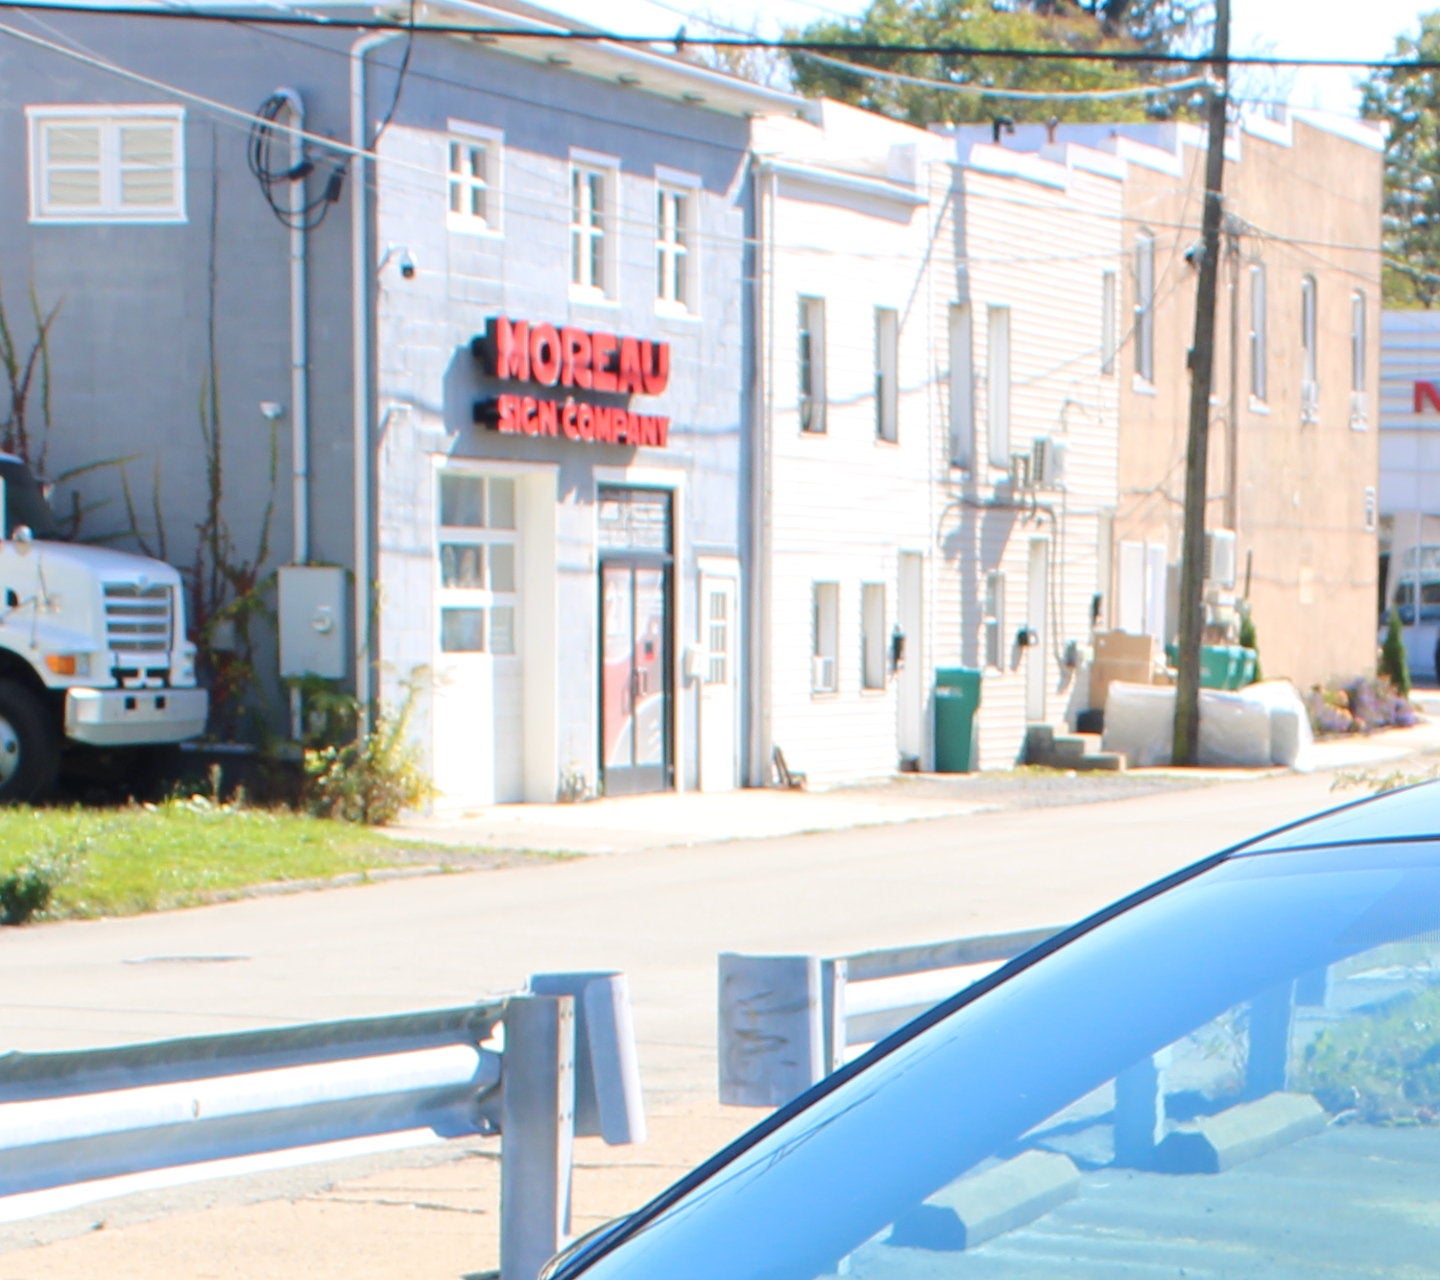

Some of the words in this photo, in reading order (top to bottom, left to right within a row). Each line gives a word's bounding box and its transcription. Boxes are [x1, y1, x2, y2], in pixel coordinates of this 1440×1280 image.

[496, 316, 670, 396] MOREAU
[497, 394, 558, 438] SIGN
[562, 397, 671, 448] COMPANY
